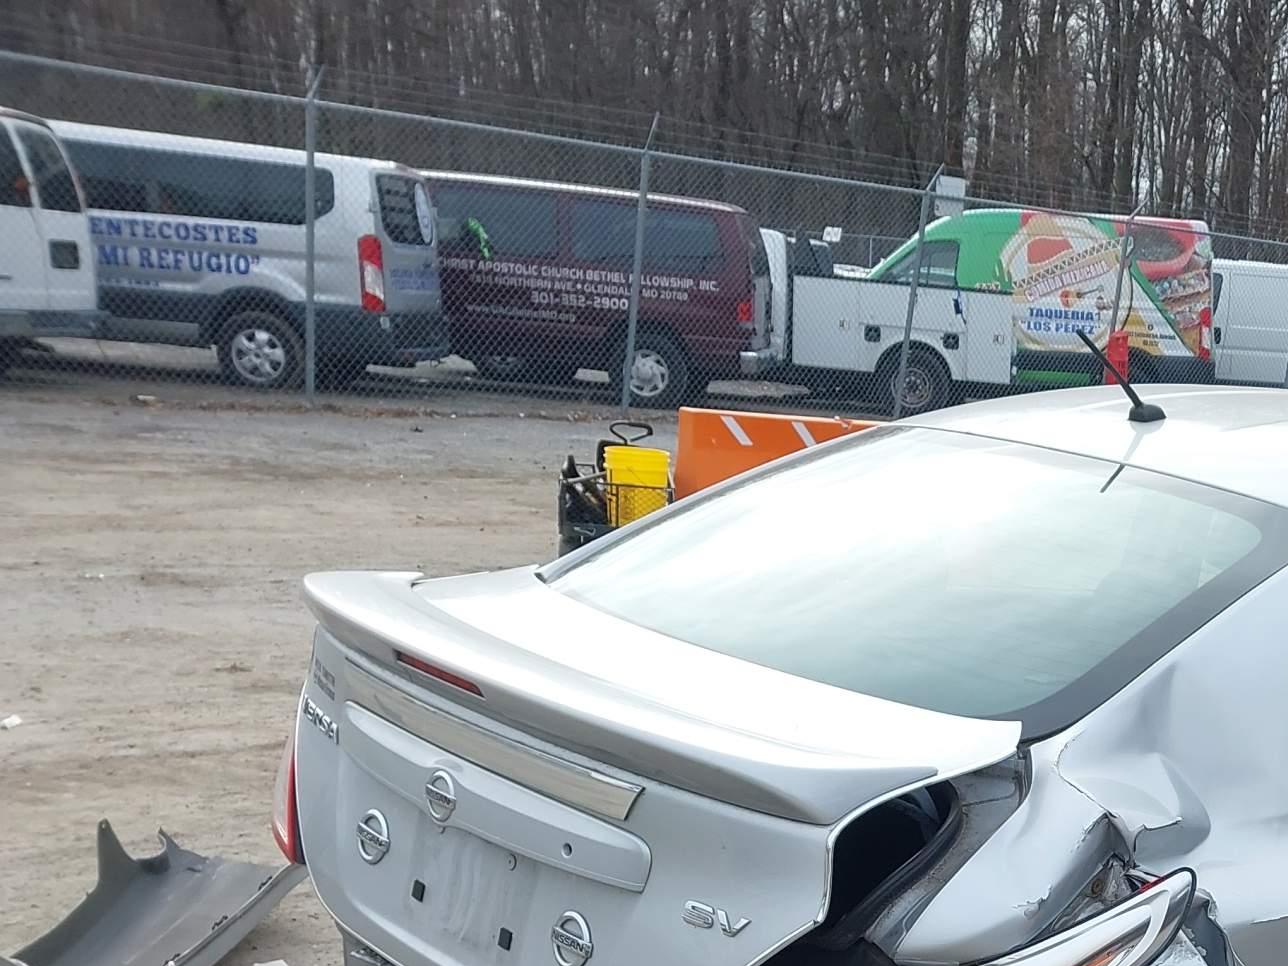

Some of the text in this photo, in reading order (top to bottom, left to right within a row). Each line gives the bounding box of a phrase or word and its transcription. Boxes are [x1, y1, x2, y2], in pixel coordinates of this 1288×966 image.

[478, 260, 539, 276] APOSTOLIC
[541, 265, 584, 280] CHURCH
[586, 269, 626, 283] BETHEL
[699, 280, 720, 292] INC.
[495, 275, 551, 290] NORTHERN
[584, 283, 632, 296] GLENDAL
[682, 899, 752, 938] SV
[551, 930, 590, 953] NISSAN
